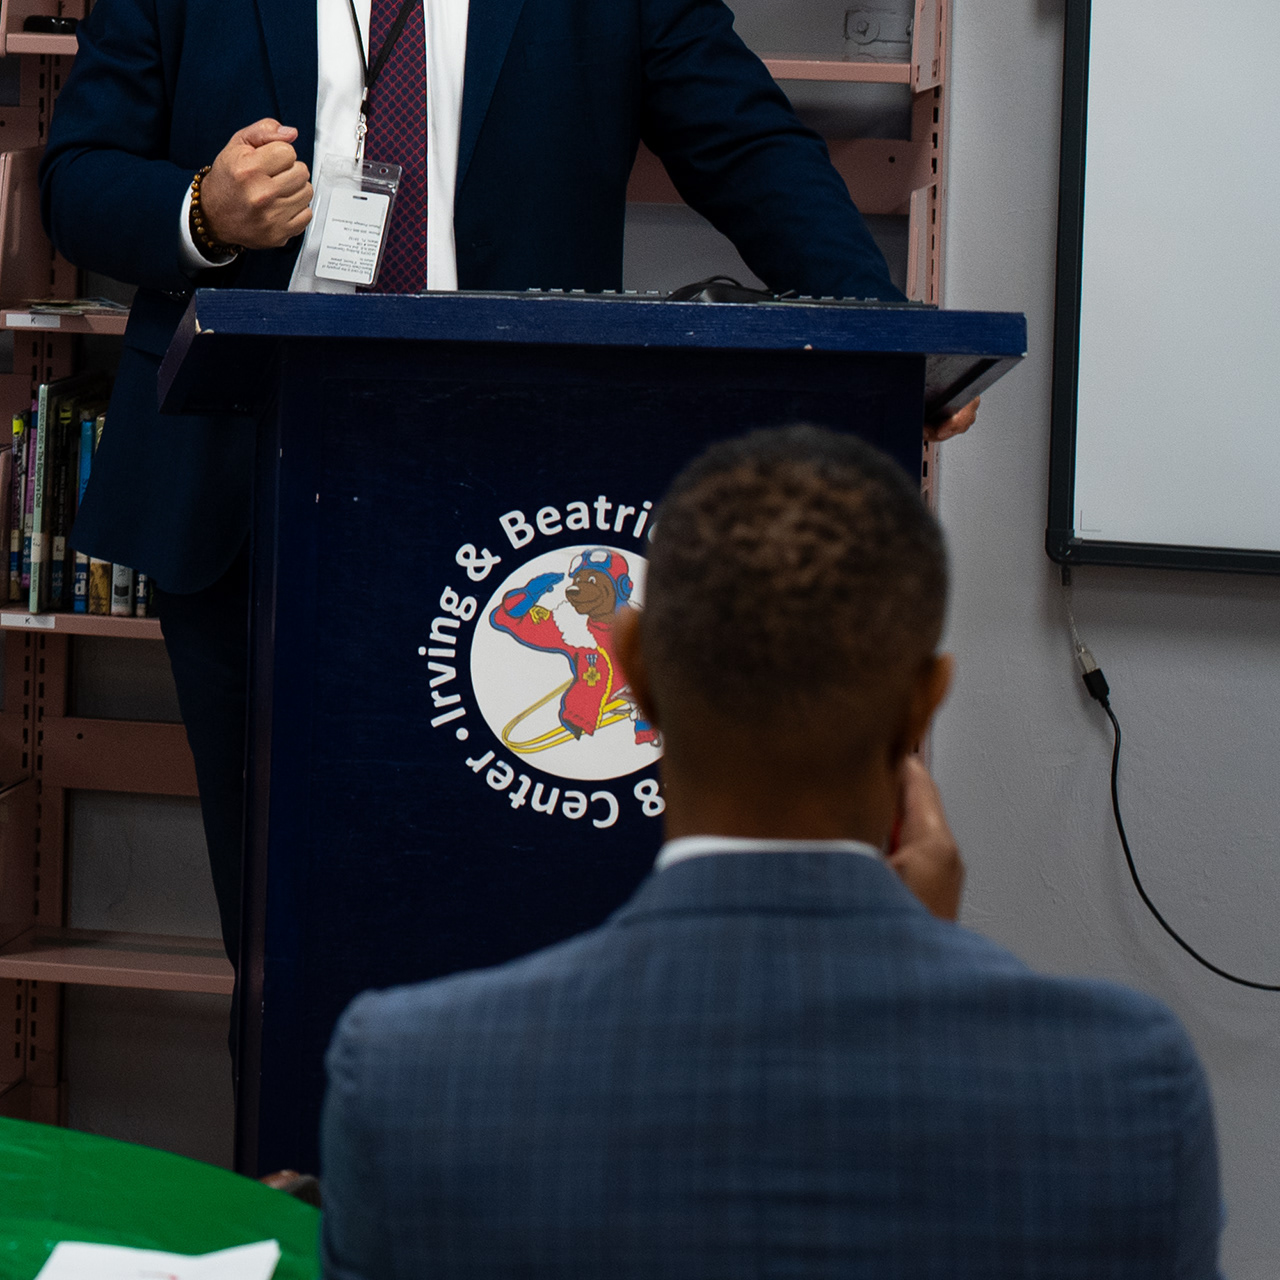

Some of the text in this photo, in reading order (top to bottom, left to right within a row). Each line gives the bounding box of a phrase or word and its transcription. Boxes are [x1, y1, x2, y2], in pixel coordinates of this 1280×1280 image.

[30, 316, 37, 324] K
[35, 462, 44, 492] Elephant's
[35, 493, 43, 508] Child
[24, 617, 31, 625] K
[418, 494, 661, 729] Irving & Beatri
[467, 750, 620, 829] Center
